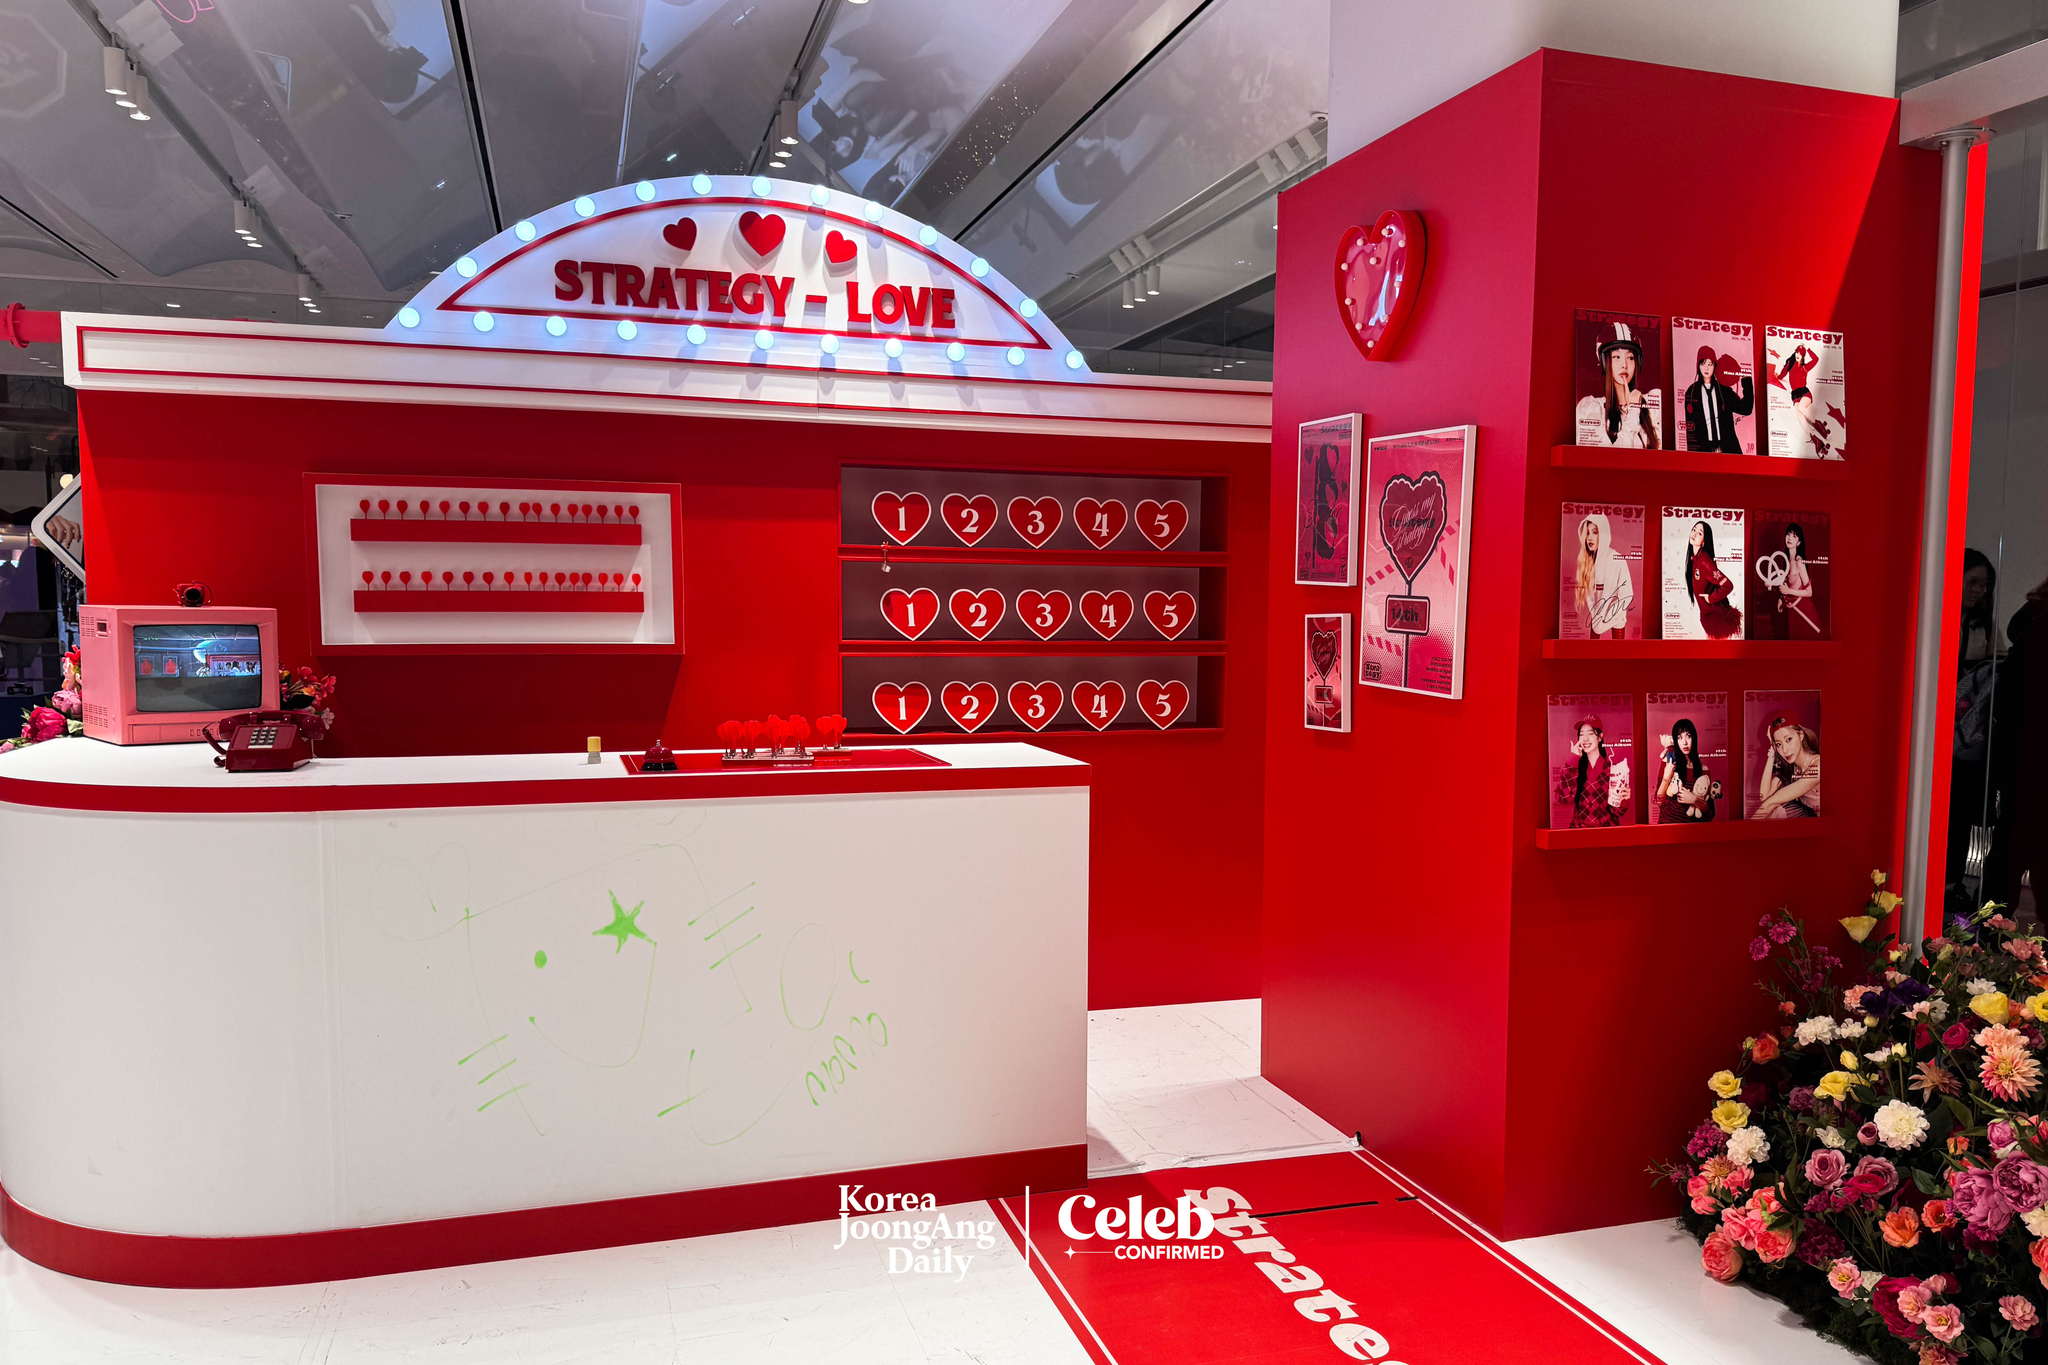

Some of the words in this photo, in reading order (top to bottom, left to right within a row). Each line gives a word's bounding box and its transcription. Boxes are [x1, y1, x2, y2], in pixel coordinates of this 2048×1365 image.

[555, 259, 795, 317] STRATEGY
[846, 281, 956, 329] LOVE
[1576, 310, 1660, 329] Strategy
[1673, 317, 1752, 336] Strategy
[1767, 326, 1842, 345] Strategy
[898, 507, 906, 531] 1
[961, 509, 978, 532] 2
[1028, 511, 1044, 534] 3
[1562, 503, 1644, 519] Strategy
[1663, 507, 1744, 522] Strategy
[1754, 510, 1830, 526] Strategy
[1092, 513, 1109, 536] 4
[1155, 514, 1169, 537] 5
[907, 603, 915, 626] 1
[969, 603, 987, 627] 2
[1036, 604, 1053, 627] 3
[1100, 605, 1116, 628] 4
[1163, 605, 1178, 627] 5
[1392, 608, 1419, 622] 14th
[899, 696, 906, 720] 1
[961, 695, 979, 719] 2
[1028, 695, 1045, 718] 3
[1091, 695, 1108, 718] 4
[1156, 694, 1171, 716] 5
[1548, 695, 1632, 707] Strategy
[1648, 693, 1727, 705] Strategy
[1184, 1186, 1411, 1365] Strate
